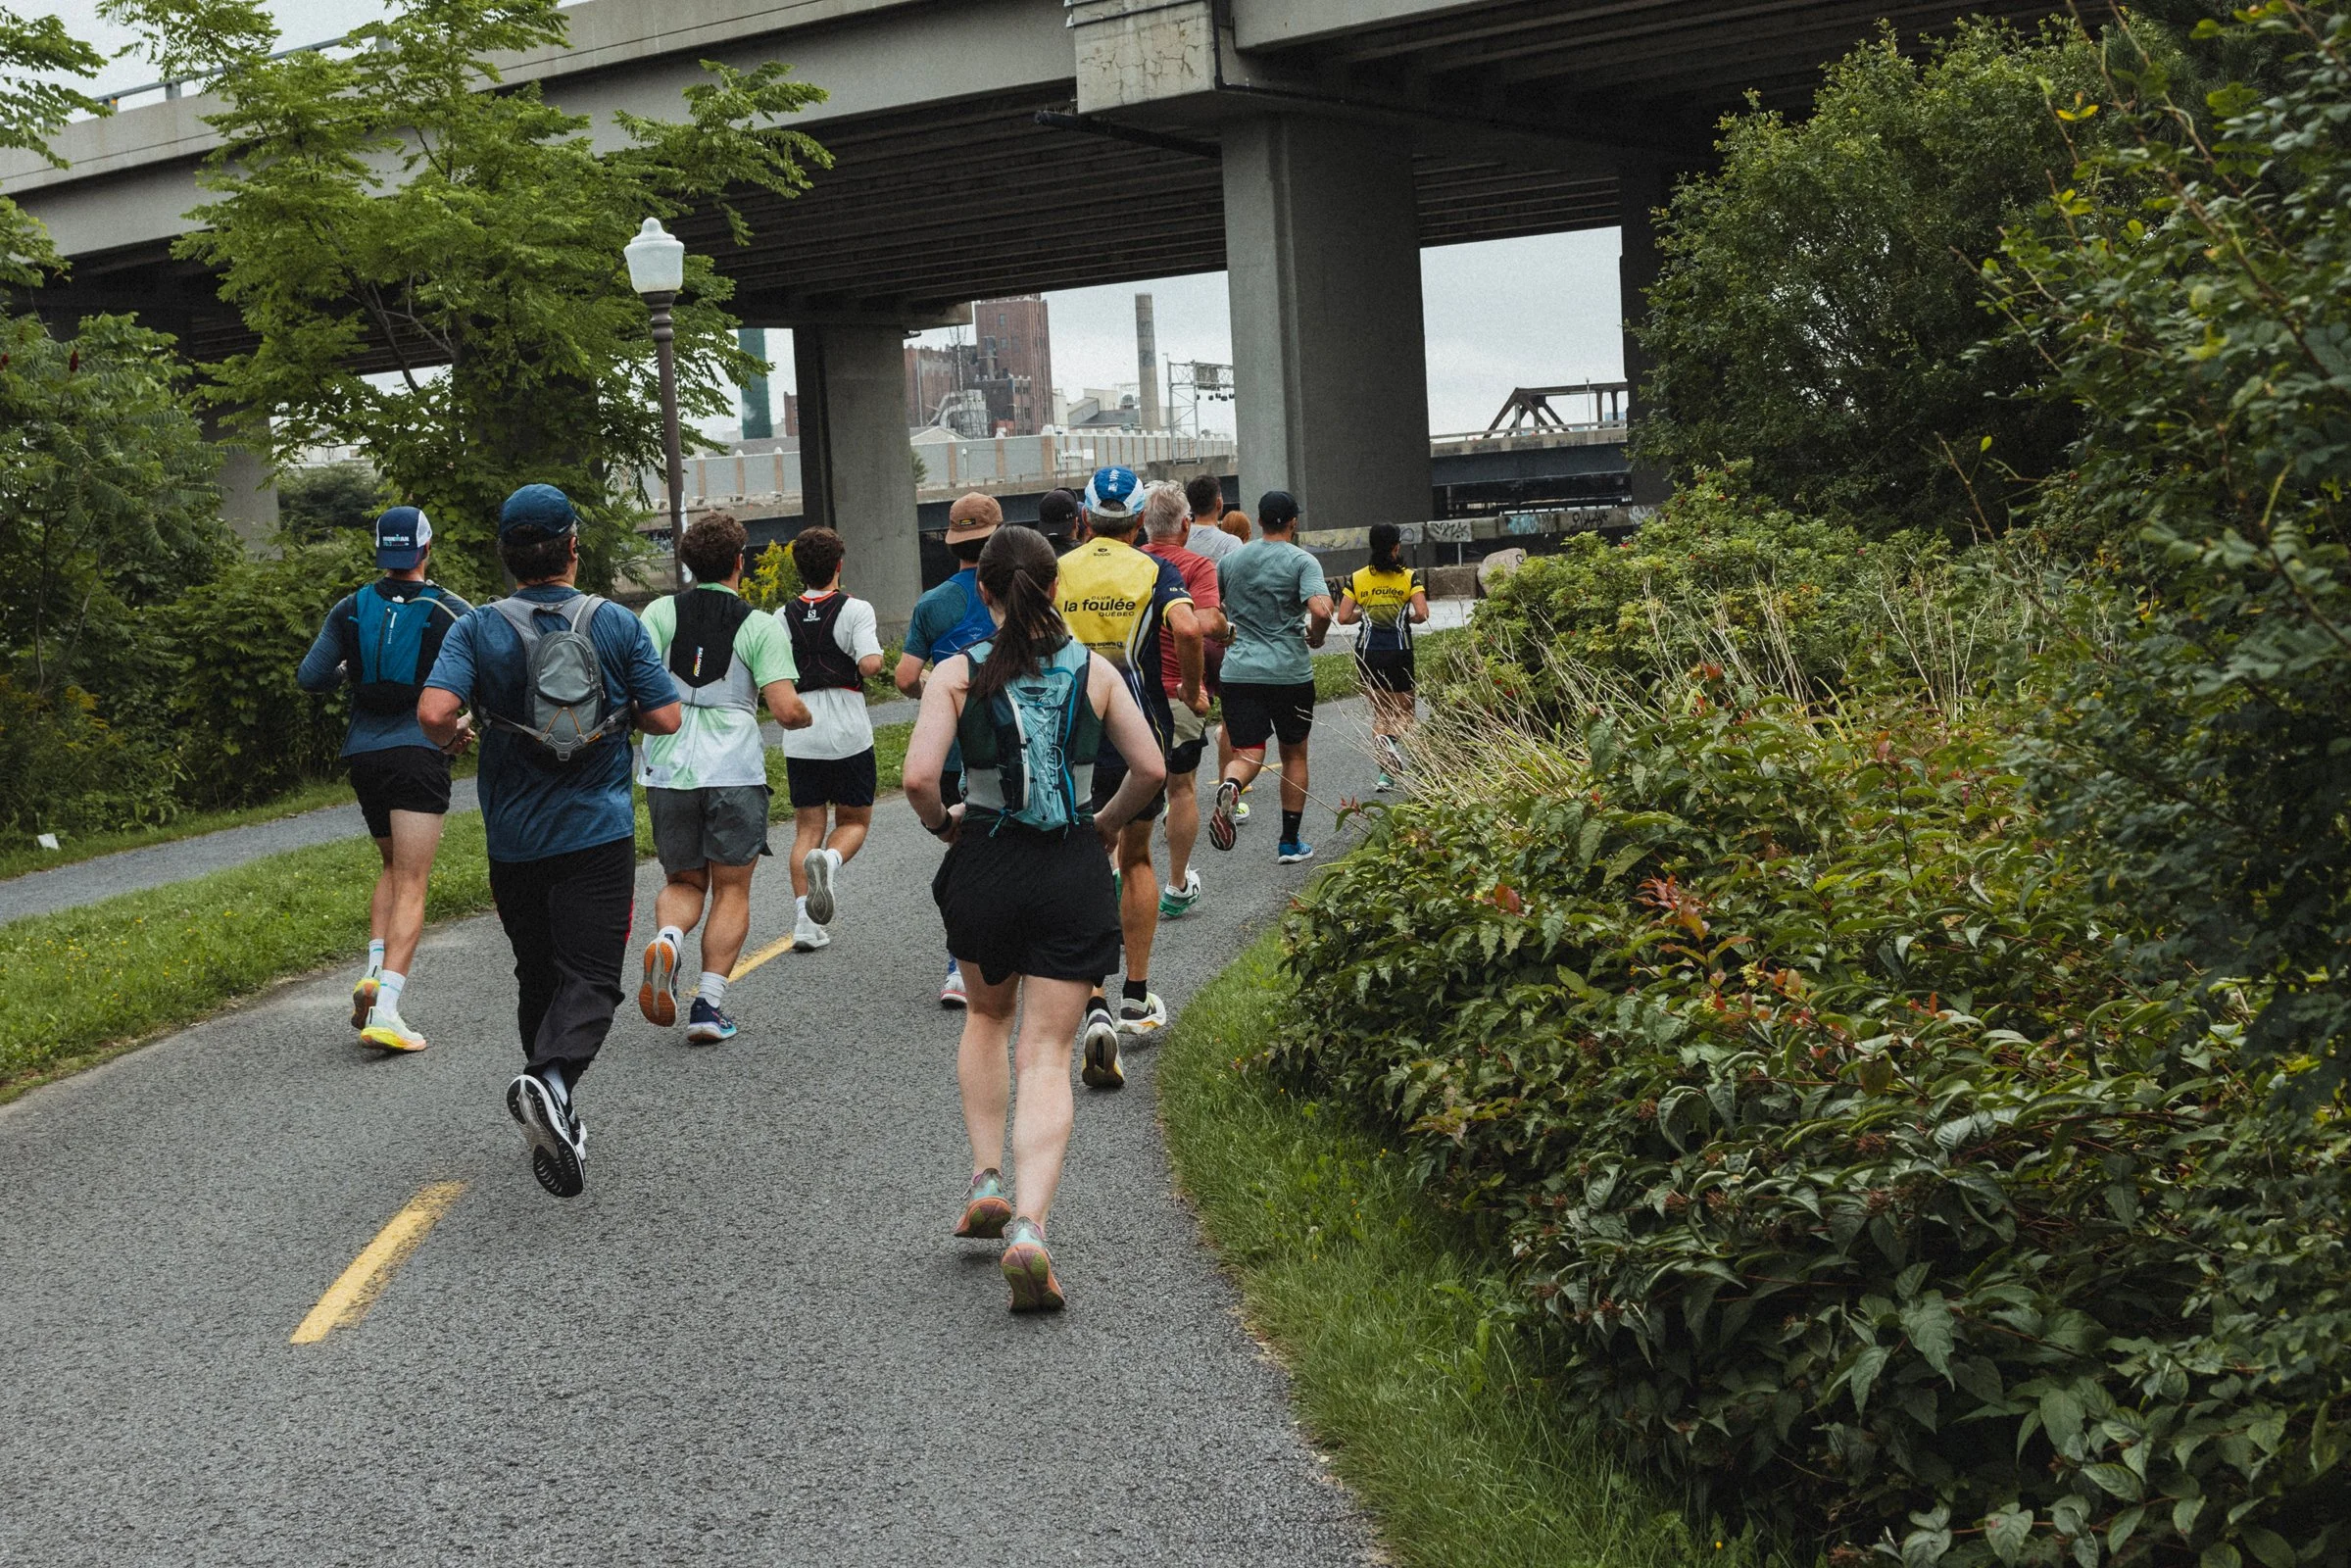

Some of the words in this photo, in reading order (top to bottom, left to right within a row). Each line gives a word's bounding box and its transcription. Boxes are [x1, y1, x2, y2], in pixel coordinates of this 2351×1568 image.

[1360, 590, 1369, 599] la
[1063, 600, 1078, 612] la
[1082, 598, 1136, 612] foulée
[693, 646, 704, 677] SALOMON
